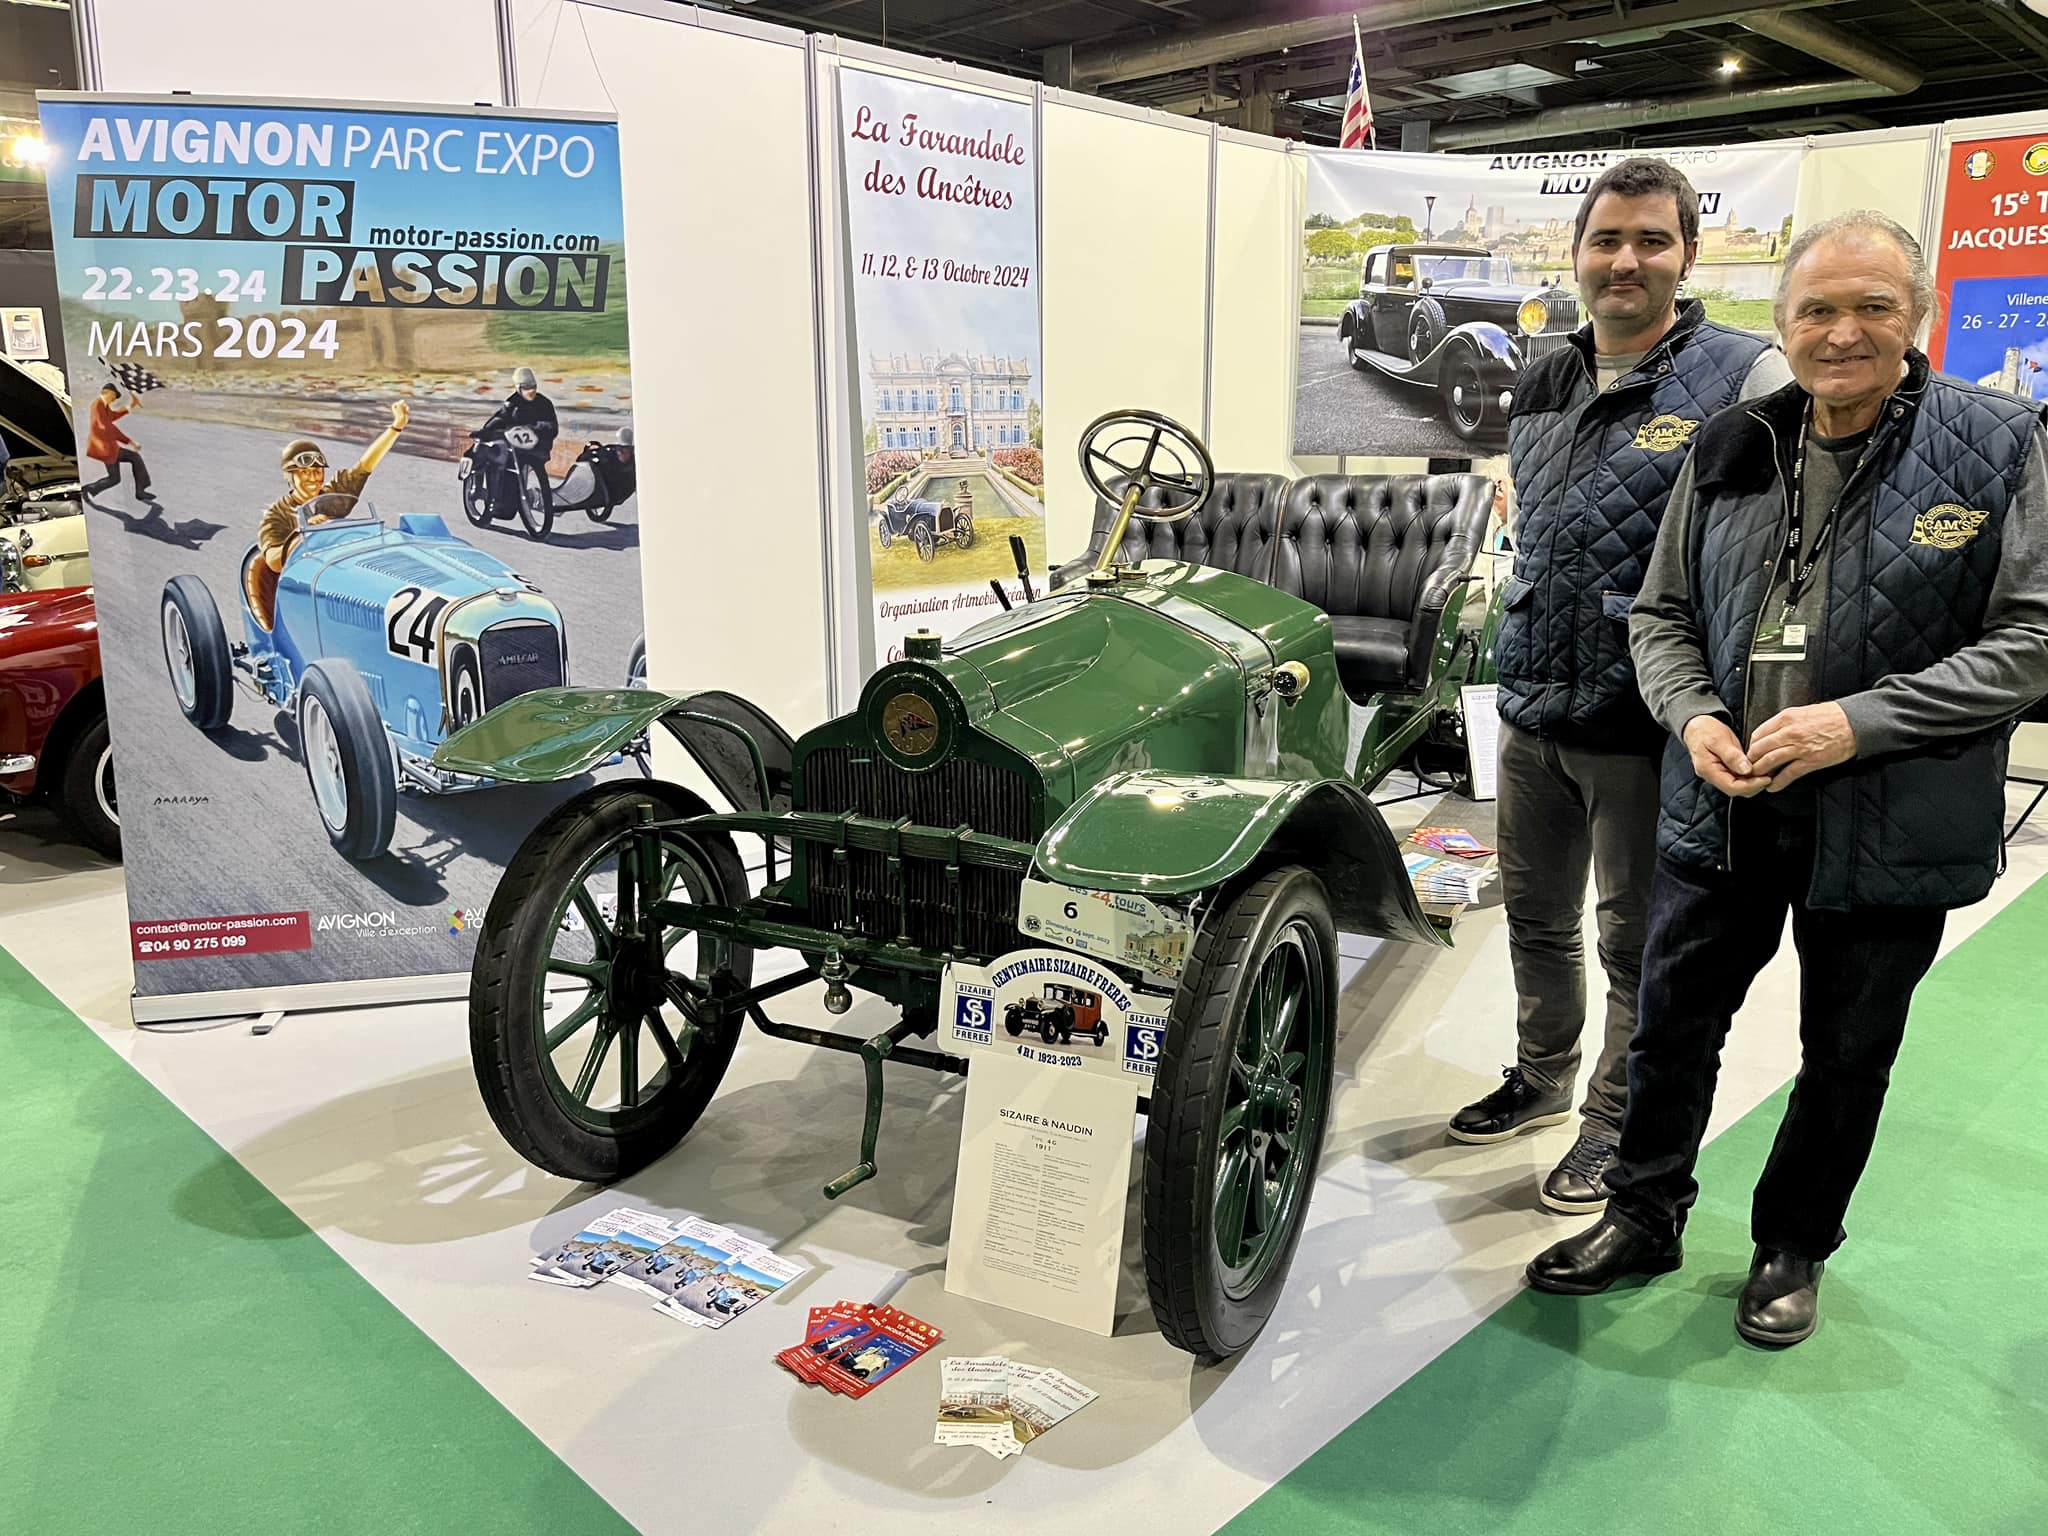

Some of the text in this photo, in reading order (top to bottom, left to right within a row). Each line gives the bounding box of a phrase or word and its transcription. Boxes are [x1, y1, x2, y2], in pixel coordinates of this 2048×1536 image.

[851, 105, 1026, 166] La Farandole
[77, 118, 596, 179] AVIGNON PARC EXPO
[1489, 152, 1608, 170] AVIGNON
[864, 160, 1013, 210] des Ancêtres
[90, 178, 346, 238] MOTOR
[369, 224, 600, 254] motor-passion.com
[1947, 224, 2048, 250] JACQUES
[300, 249, 601, 308] PASSION
[922, 258, 939, 280] 13
[943, 259, 991, 285] Octobre
[993, 265, 1029, 288] 2024
[1961, 314, 1983, 329] 26
[1998, 313, 2020, 328] 27
[87, 317, 340, 360] MARS 2024
[513, 432, 533, 446] 12
[880, 596, 949, 622] Organisation
[388, 587, 449, 665] 24
[498, 652, 540, 666] AMILCAR
[1063, 901, 1079, 919] 6
[136, 915, 298, 935] contact@motor-passion.com
[317, 911, 397, 932] AVIGNON
[355, 925, 437, 938] Ville d'exception
[173, 939, 190, 951] 90
[194, 937, 219, 950] 275
[222, 935, 247, 948] 099
[958, 984, 993, 997] SIZAIRE
[991, 957, 1132, 1012] CENTENAIRE SIZAIRE FRERES
[1129, 1014, 1168, 1027] SIZAIRE
[955, 1029, 990, 1043] FRERES
[1038, 1051, 1083, 1067] 1923-2023
[1126, 1061, 1158, 1075] FRERE
[999, 1108, 1040, 1125] SIZAIRE
[1041, 1118, 1049, 1127] &
[1050, 1119, 1093, 1136] NAUDIN
